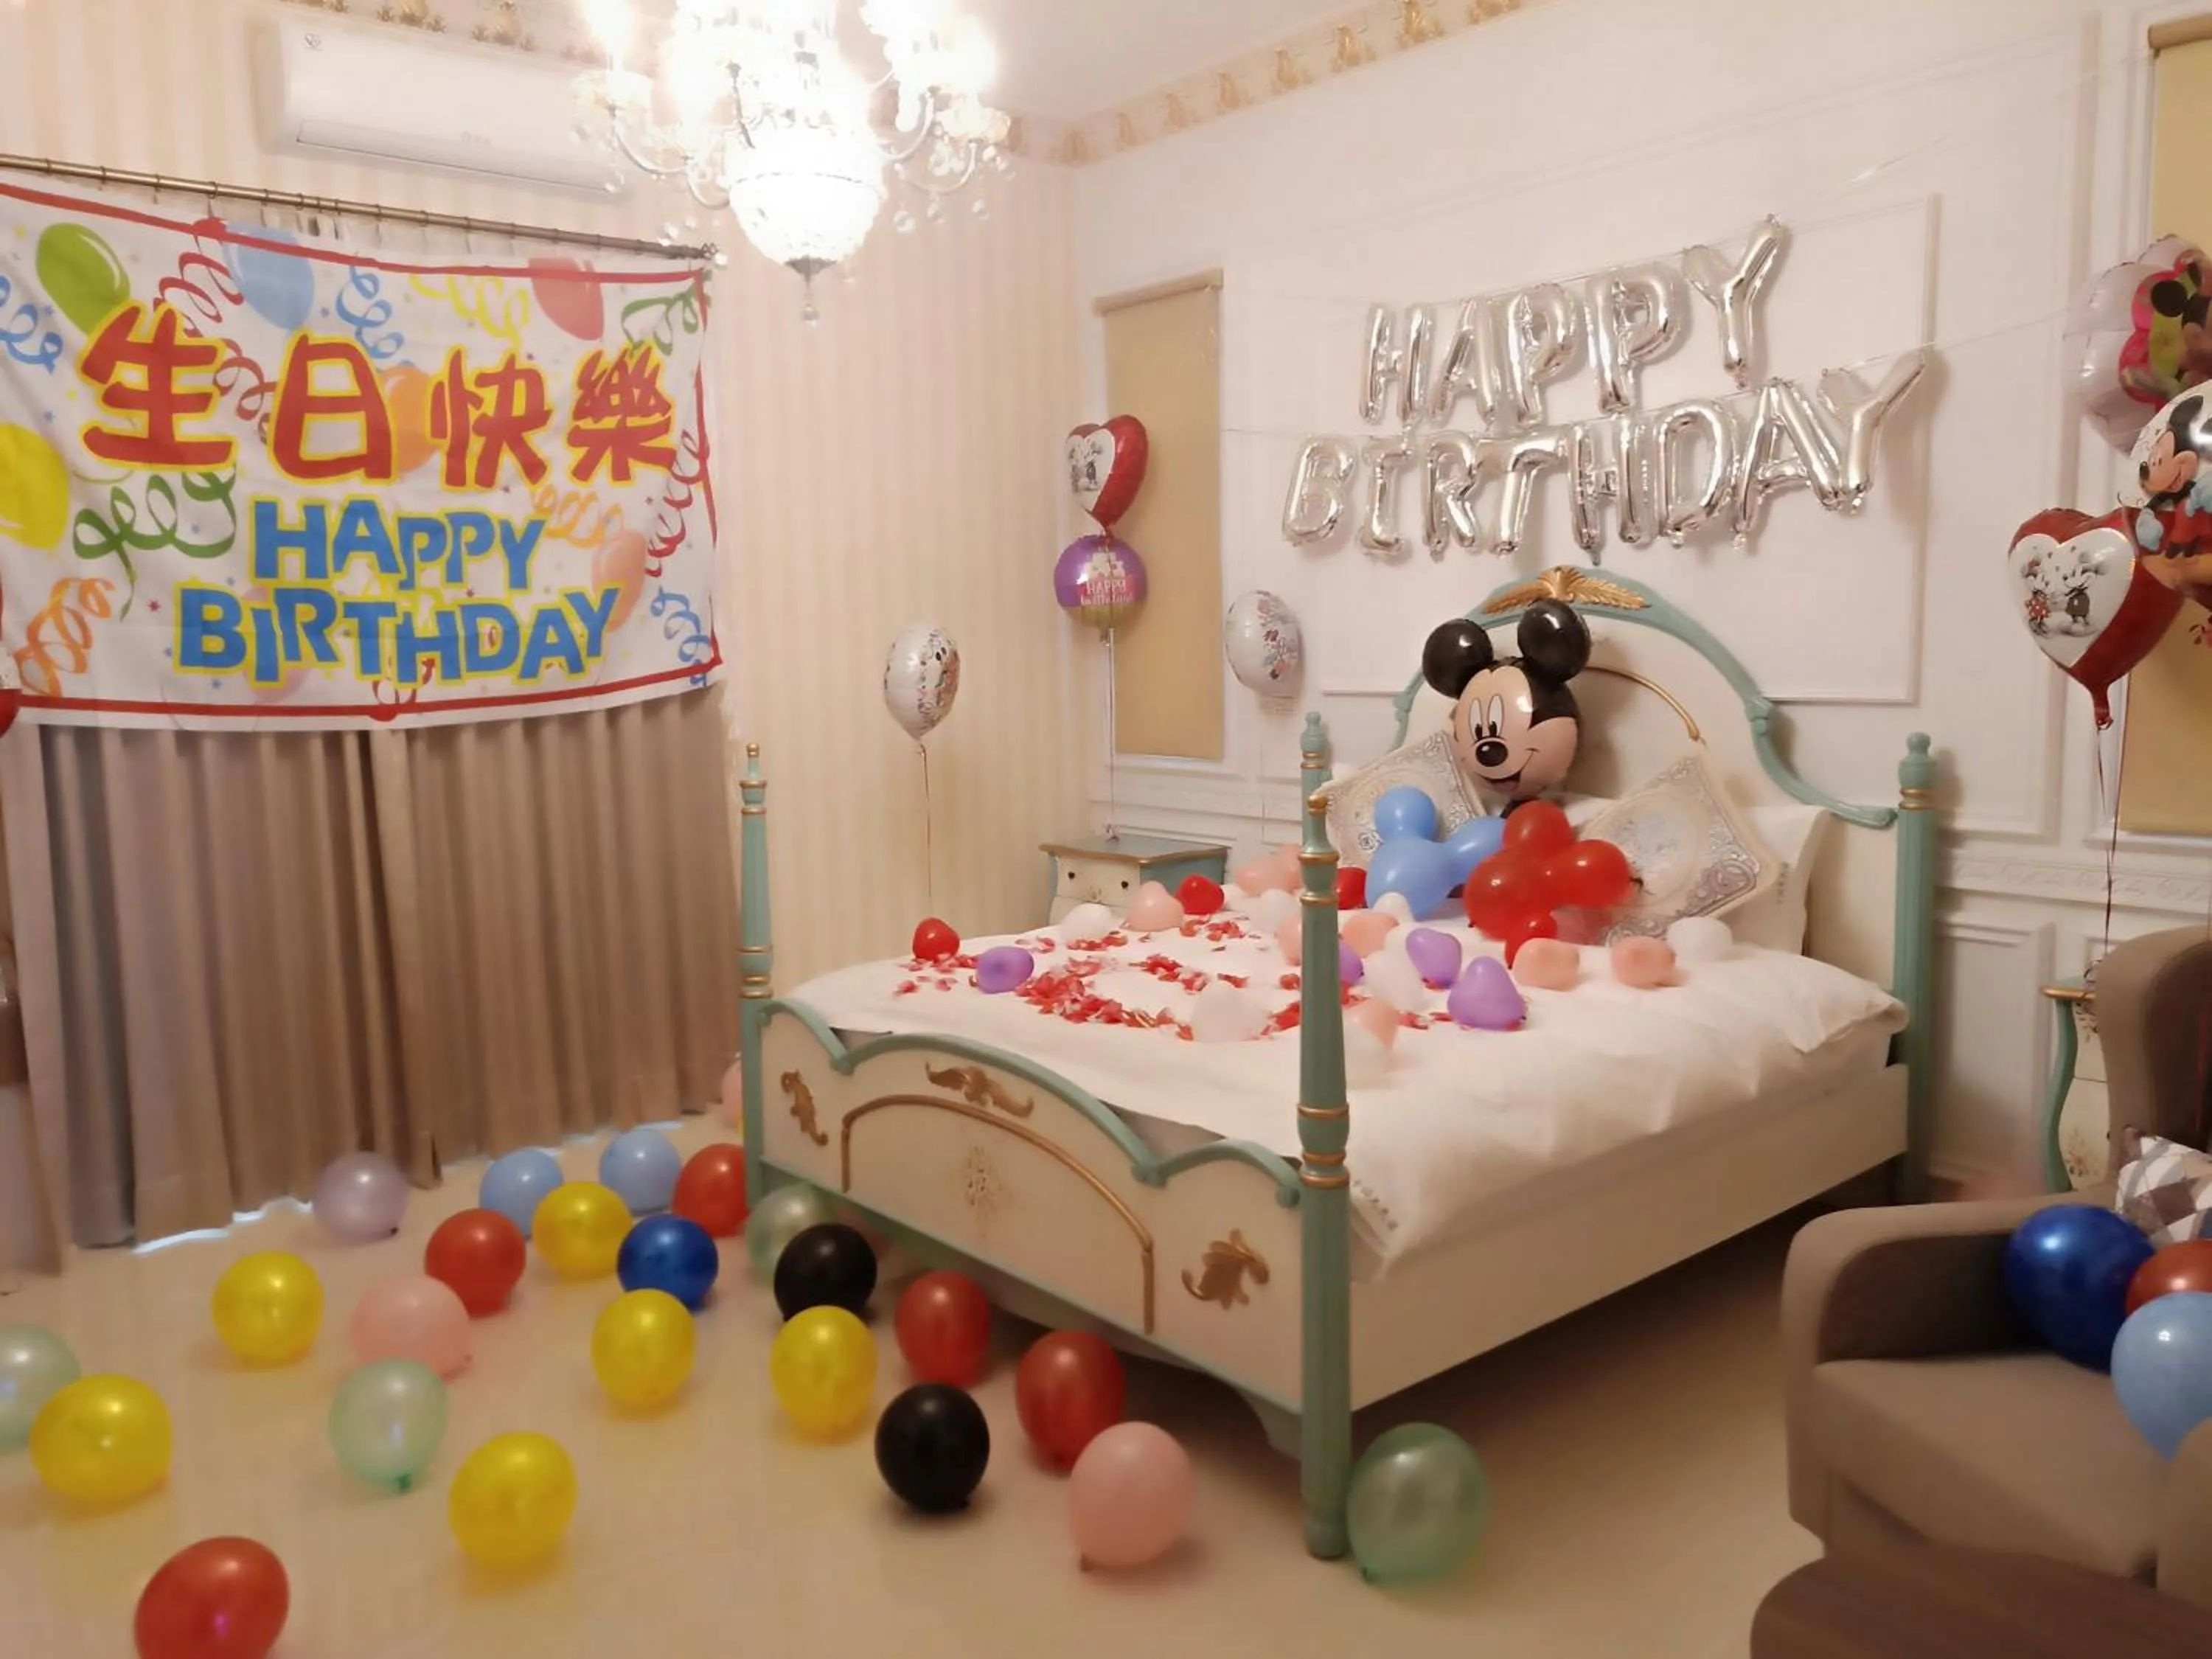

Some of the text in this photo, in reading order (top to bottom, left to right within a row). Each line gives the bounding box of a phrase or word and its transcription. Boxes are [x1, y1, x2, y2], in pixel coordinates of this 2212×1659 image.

[78, 302, 678, 487] 生日快樂
[1357, 214, 1783, 423] HAPPY
[251, 497, 546, 591] HAPPY
[1281, 349, 1926, 563] BIRTHDAY
[174, 585, 623, 687] BIRTHDAY
